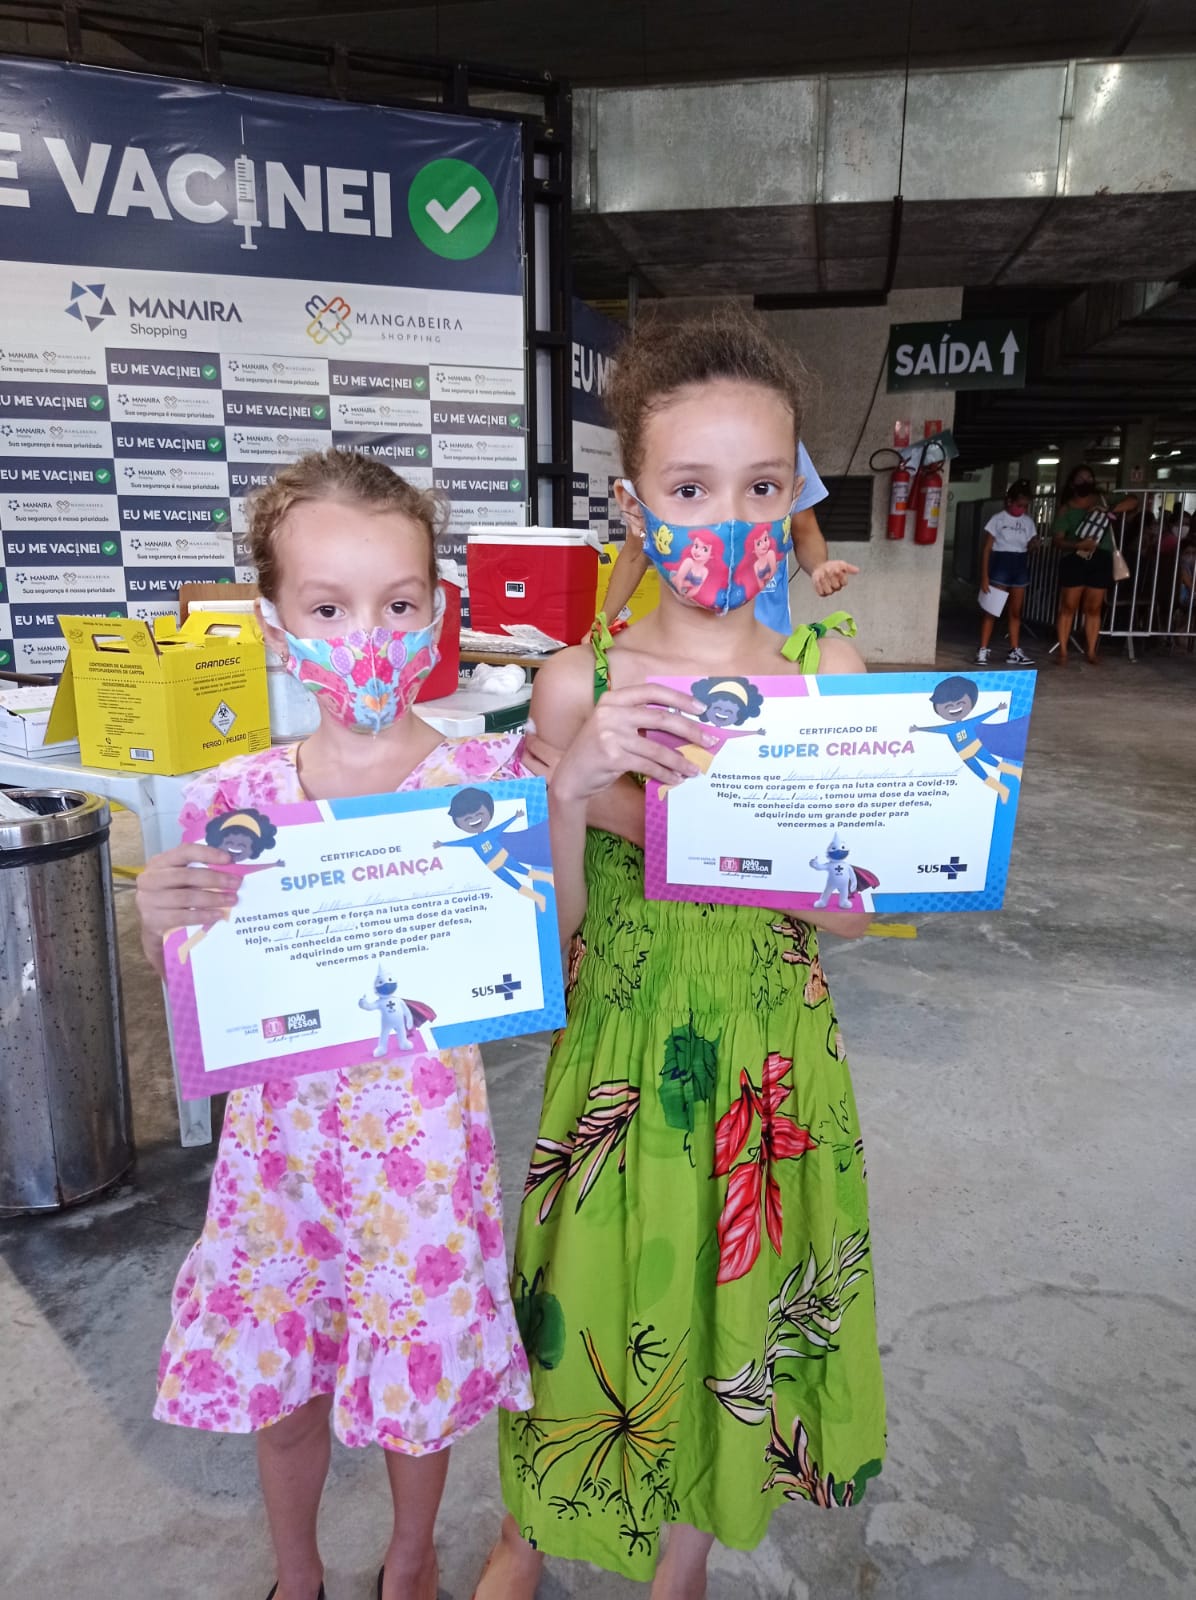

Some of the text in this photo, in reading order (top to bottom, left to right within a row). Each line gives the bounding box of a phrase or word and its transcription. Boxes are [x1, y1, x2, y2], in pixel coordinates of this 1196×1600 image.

[43, 137, 393, 249] VACINEI
[129, 297, 243, 324] MANAIRA
[356, 312, 464, 332] MANGABEIRA
[130, 324, 188, 340] Shopping
[381, 332, 441, 344] SHOPPING
[895, 334, 993, 376] SAÍDA
[110, 363, 128, 374] EU
[132, 364, 149, 374] ME
[572, 342, 593, 392] EU
[332, 375, 348, 385] EU
[351, 376, 367, 386] ME
[0, 396, 10, 406] U
[15, 396, 33, 406] ME
[227, 404, 243, 414] EU
[246, 405, 263, 415] ME
[434, 413, 448, 422] EU
[450, 414, 465, 423] ME
[117, 437, 134, 447] EU
[138, 438, 155, 448] ME
[0, 470, 18, 480] EU
[22, 470, 40, 480] ME
[232, 475, 248, 485] EU
[251, 476, 267, 485] ME
[436, 480, 449, 489] EU
[453, 480, 467, 489] ME
[123, 510, 140, 520] EU
[144, 510, 161, 520] ME
[8, 543, 24, 553] EU
[29, 543, 47, 554] ME
[236, 544, 252, 554] EU
[437, 544, 467, 554] EU ME
[129, 581, 167, 591] EU ME
[15, 615, 54, 626] EU ME
[800, 726, 863, 734] CERTIFICADO
[758, 740, 915, 758] SUPER CRIANÇA
[320, 848, 386, 862] CERTIFICADO
[281, 857, 443, 891] SUPER CRIANÇA
[917, 862, 939, 875] SUS
[234, 908, 310, 924] Atestamos que
[236, 925, 270, 935] entrou
[273, 921, 293, 930] com
[296, 914, 338, 926] coragem
[349, 910, 374, 919] força
[411, 900, 442, 910] contra
[452, 893, 493, 904] Covid-19.
[245, 935, 271, 945] Hoje,
[360, 920, 391, 928] tomou
[416, 912, 438, 920] dose
[454, 905, 487, 914] vacina,
[265, 944, 289, 954] mais
[291, 935, 342, 949] conhecida
[372, 928, 394, 937] soro
[409, 922, 436, 932] super
[438, 917, 472, 927] defesa,
[290, 947, 344, 961] adquirindo
[364, 939, 398, 951] grande
[400, 934, 428, 944] poder
[430, 931, 451, 940] para
[316, 954, 369, 967] vencermos
[379, 945, 429, 958] Pandemia.
[471, 985, 494, 998] SUS
